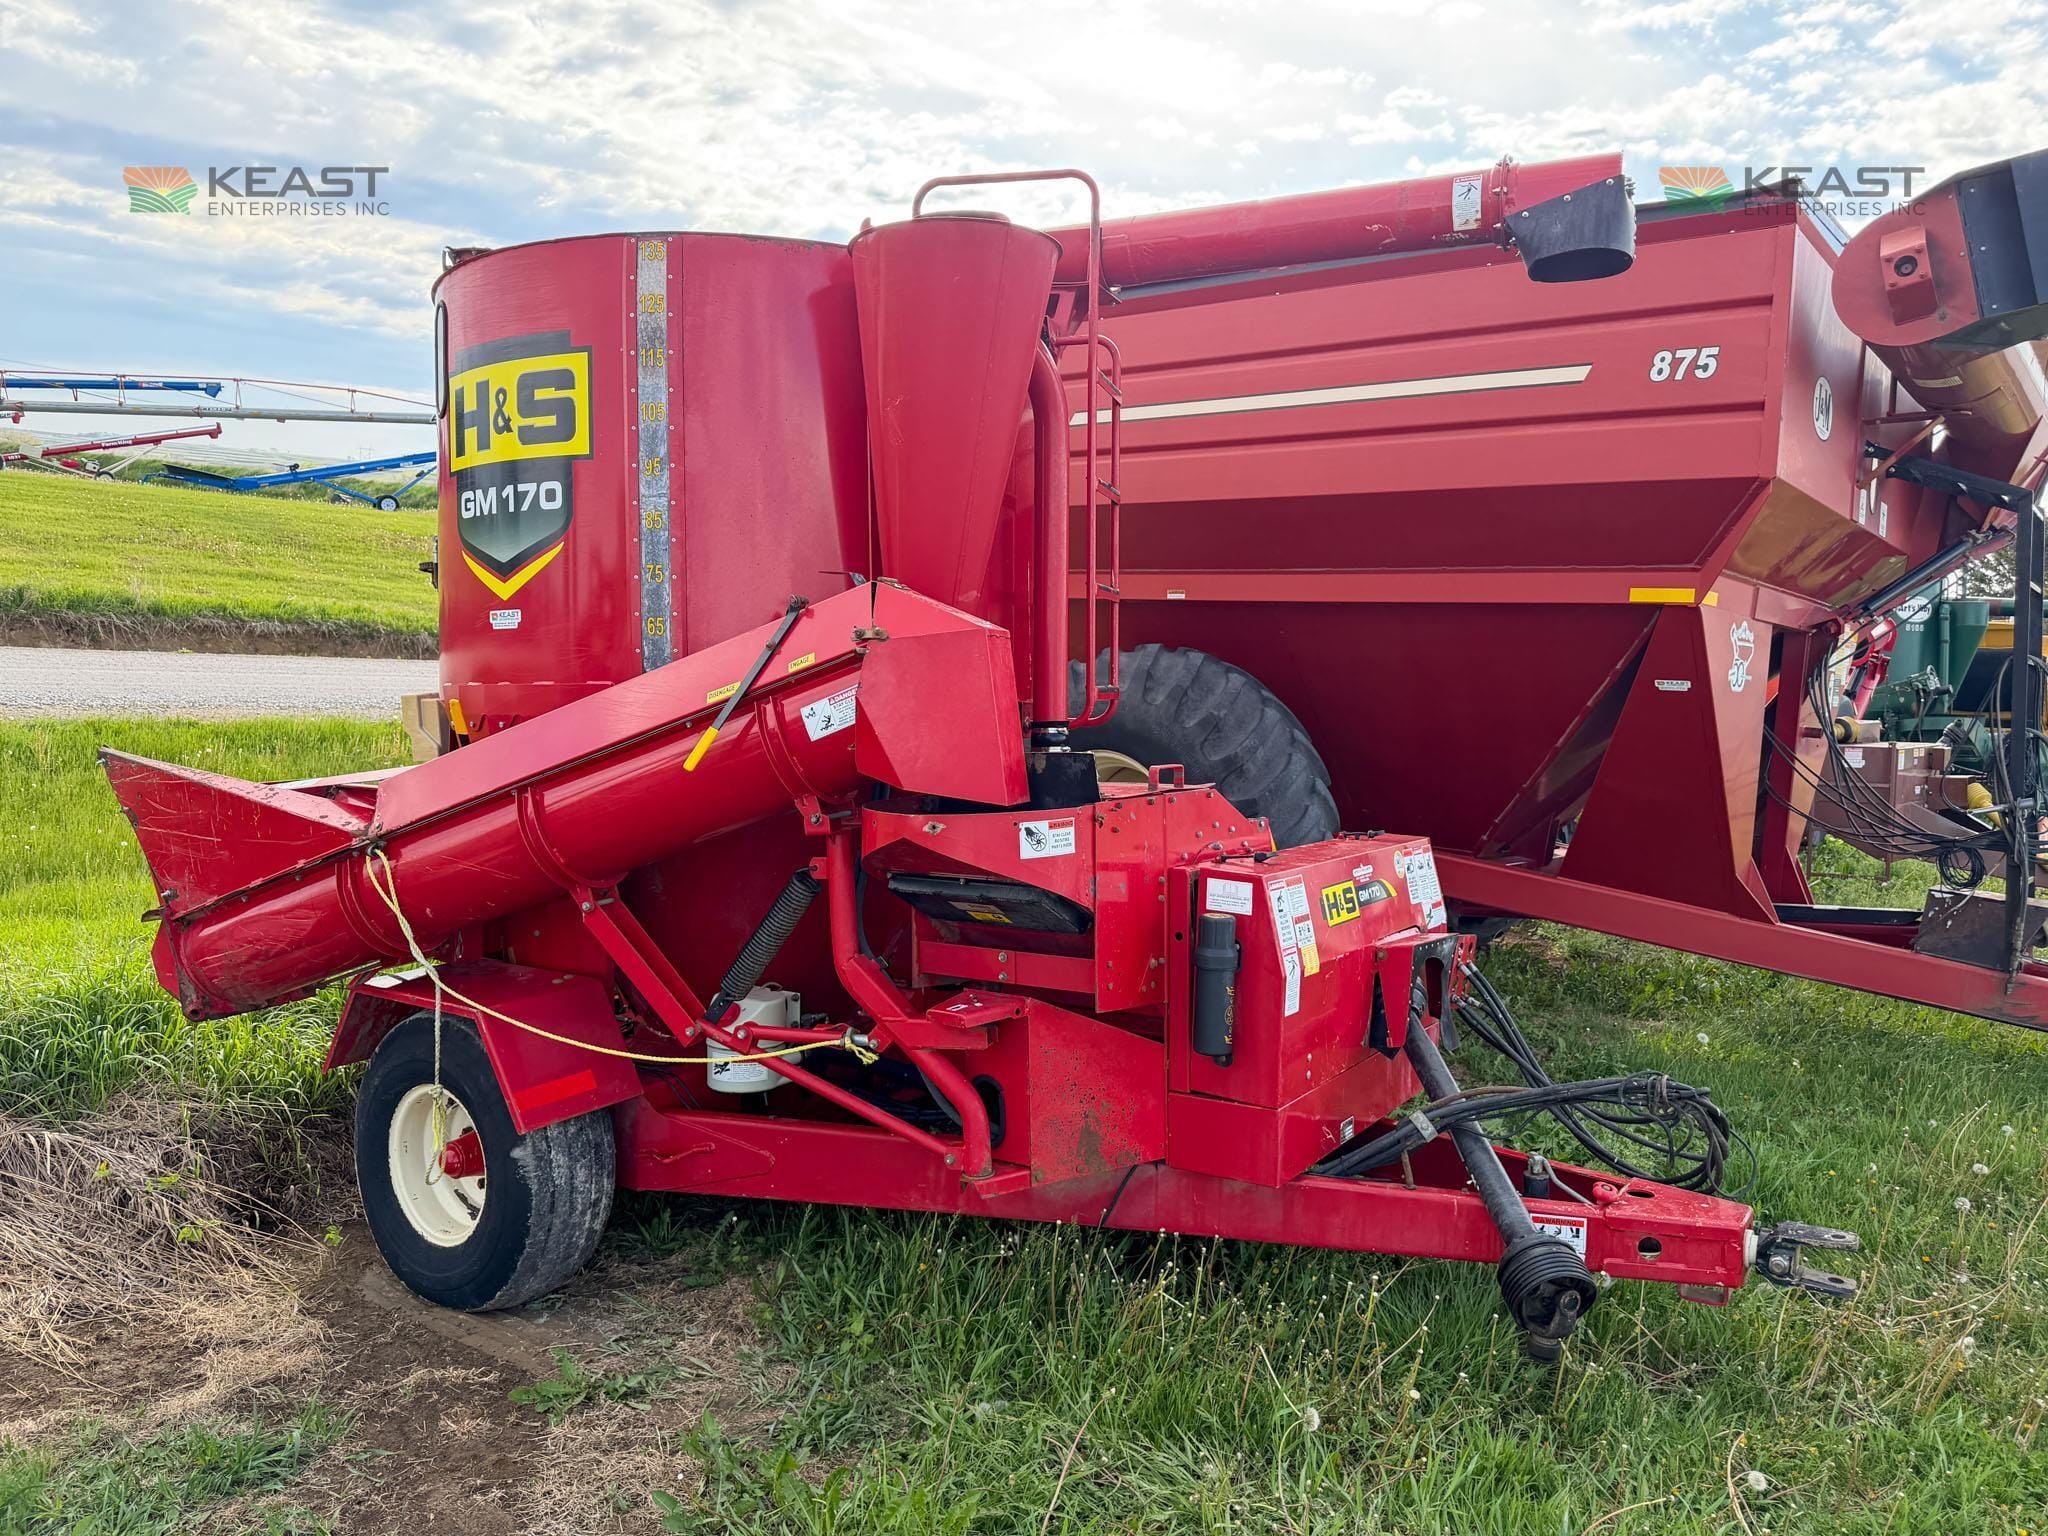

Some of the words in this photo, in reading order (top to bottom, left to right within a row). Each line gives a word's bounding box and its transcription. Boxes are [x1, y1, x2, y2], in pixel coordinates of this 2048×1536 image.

[639, 242, 665, 261] 135
[639, 294, 665, 314] 125
[640, 348, 665, 368] 115
[1649, 346, 1720, 382] 875
[454, 368, 577, 459] H&S
[640, 402, 666, 422] 105
[644, 457, 662, 476] 95
[644, 511, 662, 529] 85
[646, 564, 664, 583] 75
[646, 617, 665, 636] 65
[834, 688, 858, 702] DANGE
[1325, 886, 1357, 921] H&S
